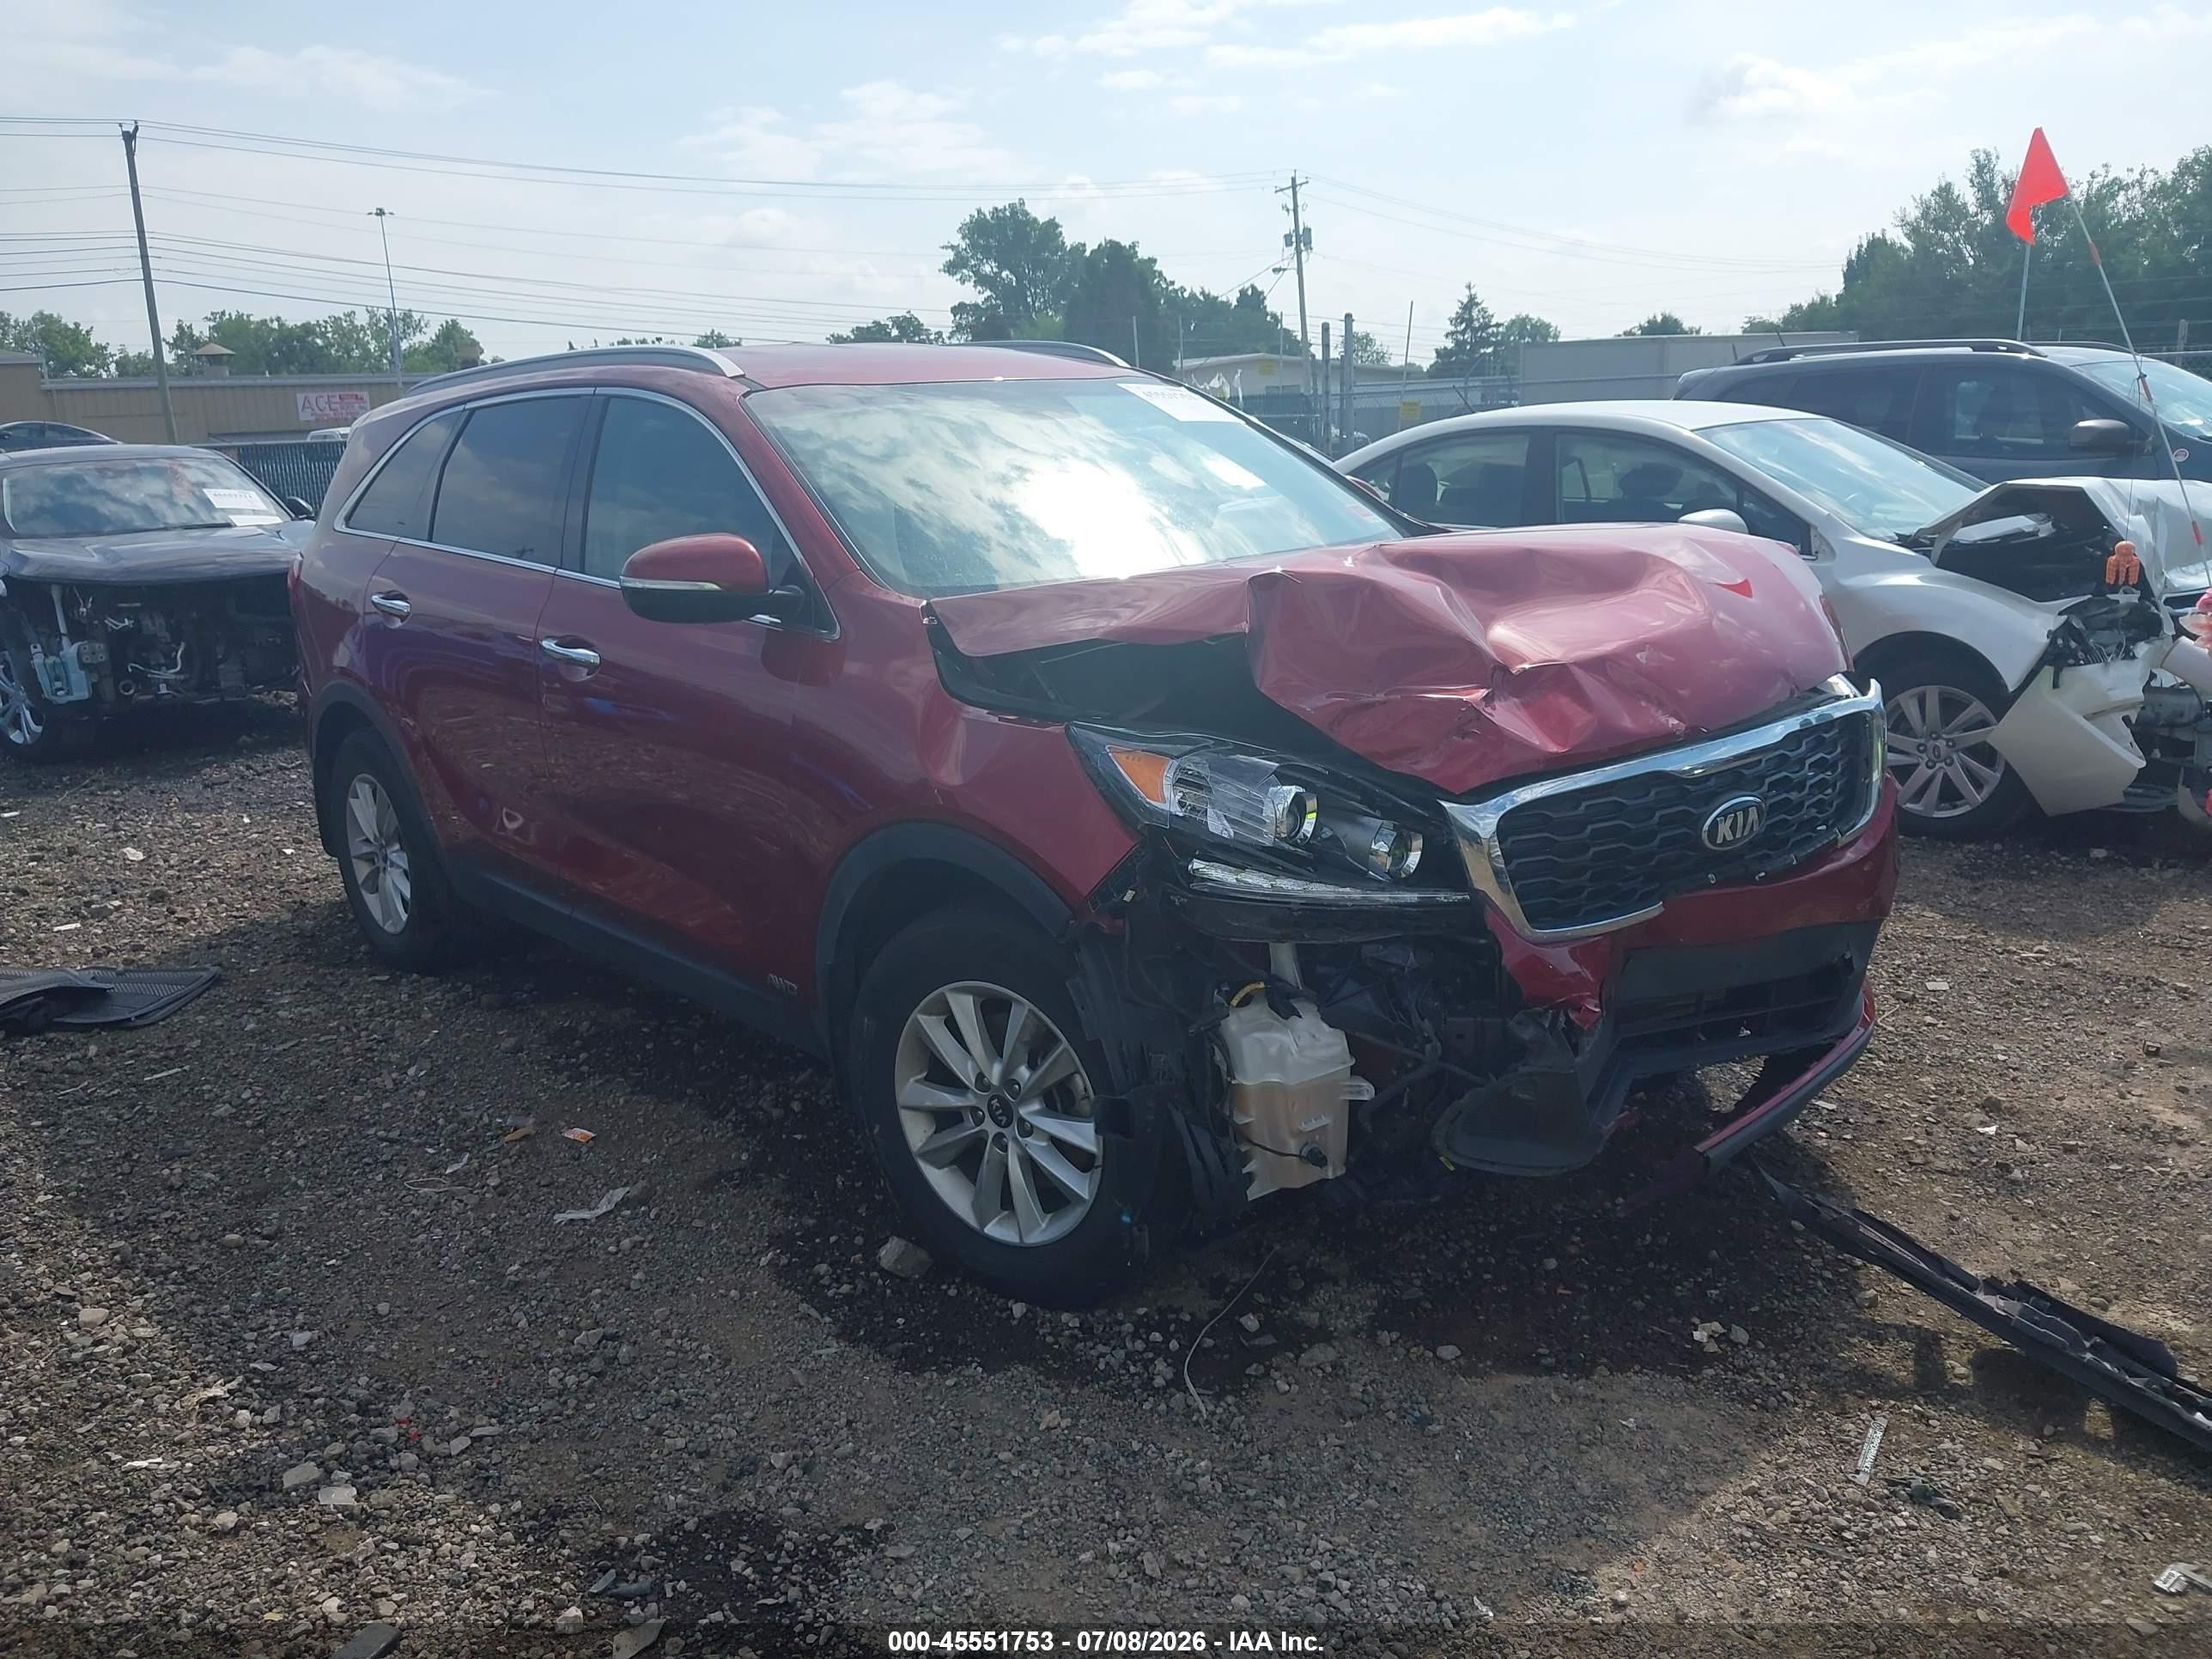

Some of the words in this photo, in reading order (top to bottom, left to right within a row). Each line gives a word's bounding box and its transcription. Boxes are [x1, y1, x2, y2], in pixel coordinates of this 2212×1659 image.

[301, 394, 337, 412] ACE
[1717, 806, 1759, 844] KIA
[1862, 1429, 1883, 1474] PERFORMANCE
